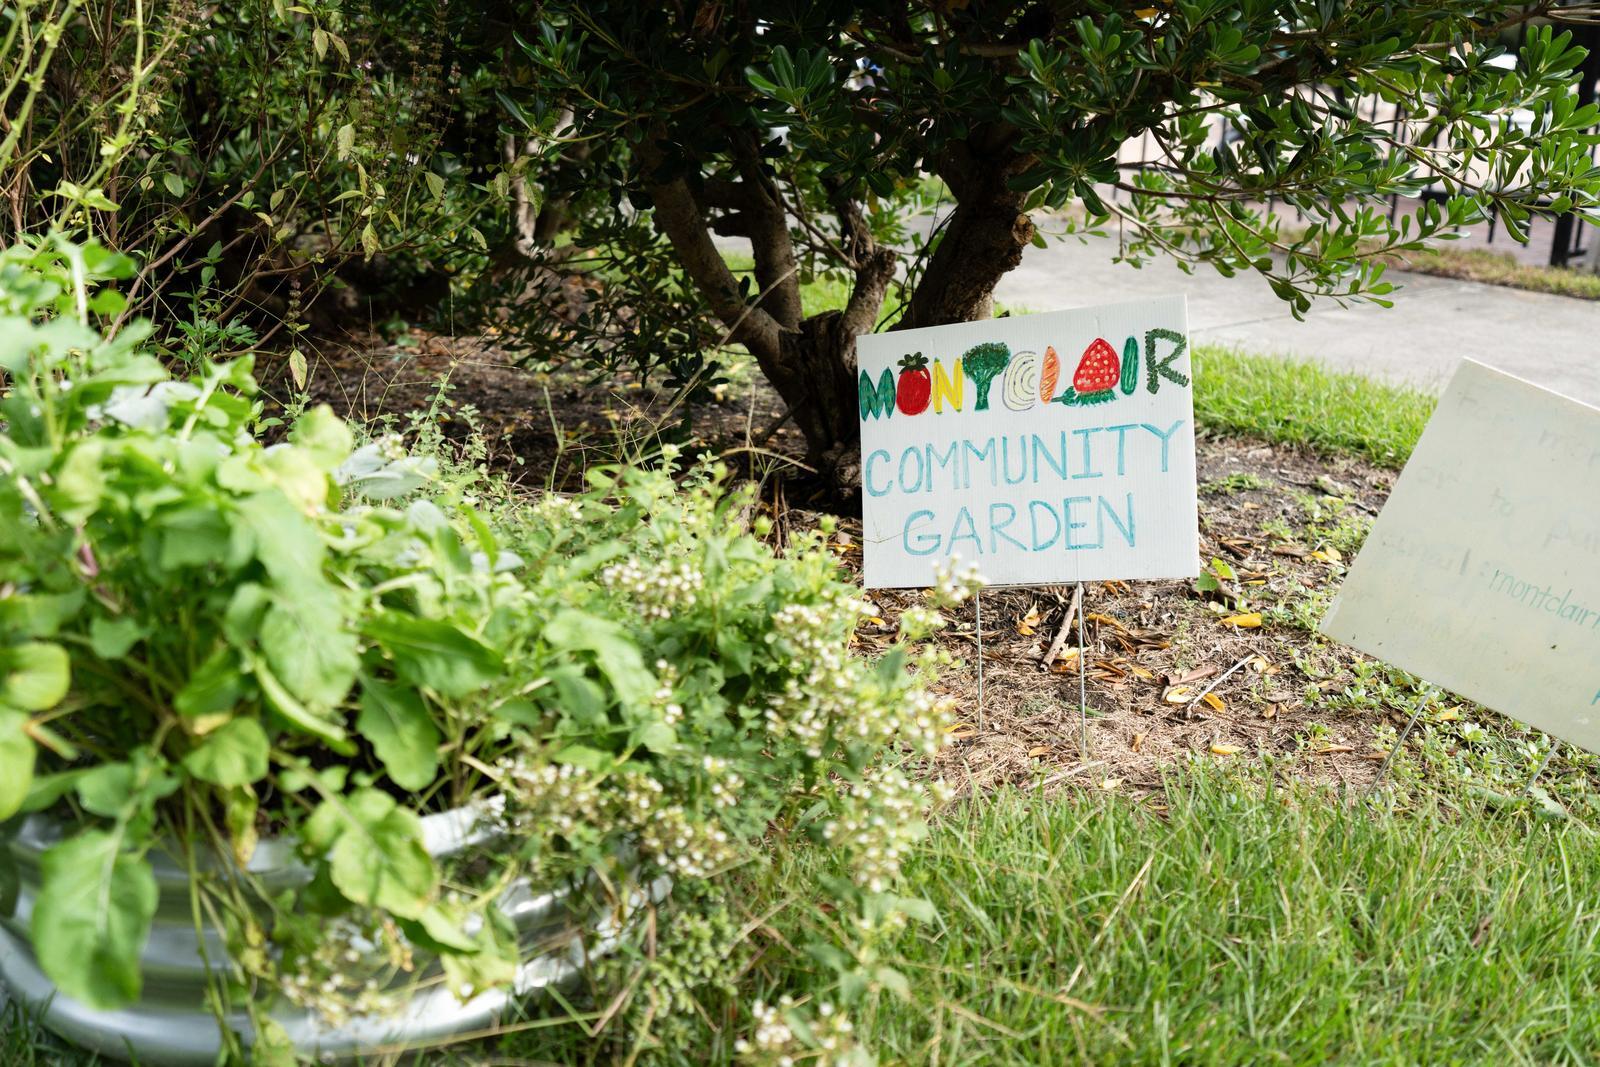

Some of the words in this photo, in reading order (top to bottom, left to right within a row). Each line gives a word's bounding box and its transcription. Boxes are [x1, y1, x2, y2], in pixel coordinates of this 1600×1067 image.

[858, 328, 1190, 421] MONTCLAIR
[865, 420, 1186, 497] COMMUNITY
[903, 492, 1135, 556] GARDEN
[1488, 568, 1600, 630] montclair
